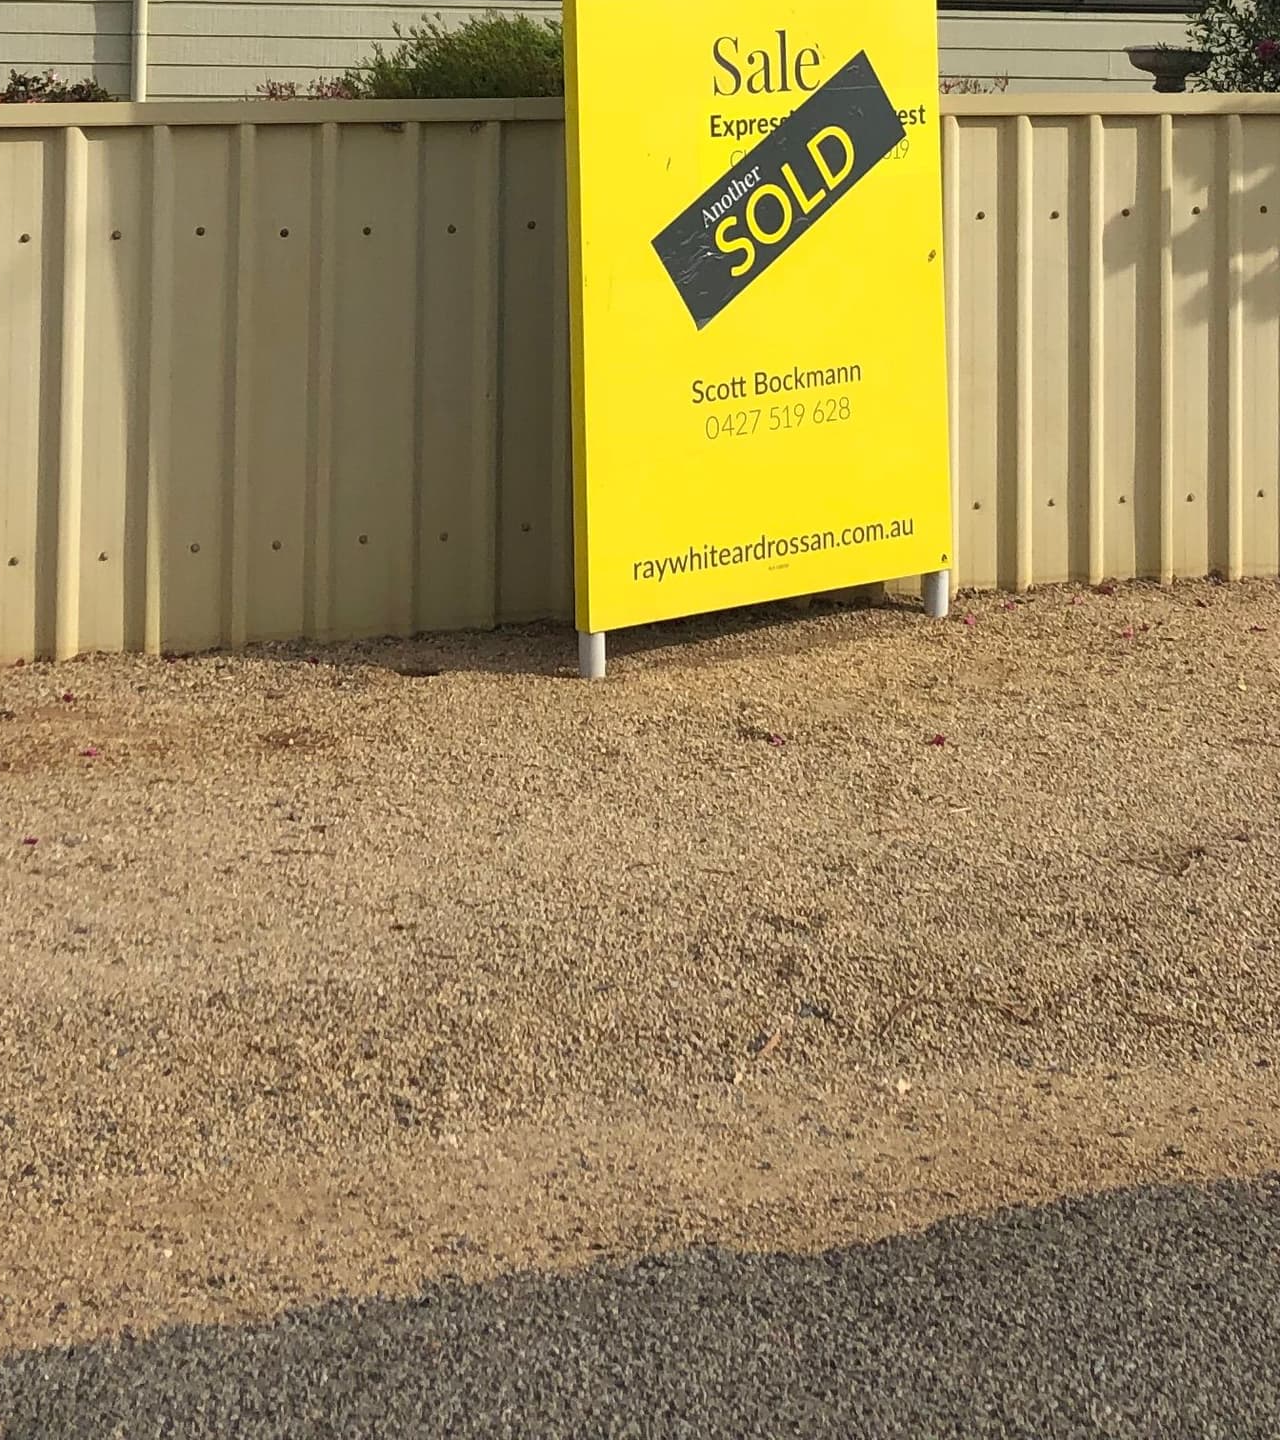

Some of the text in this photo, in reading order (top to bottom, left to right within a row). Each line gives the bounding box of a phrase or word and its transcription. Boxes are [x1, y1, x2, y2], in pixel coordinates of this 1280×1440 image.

[713, 29, 821, 96] Sale
[700, 164, 761, 228] Another
[714, 125, 855, 277] SOLD
[692, 364, 862, 404] Scott Bockmann
[705, 396, 851, 440] 0427 519 628
[633, 517, 914, 582] raywhiteardrossan.com.au
